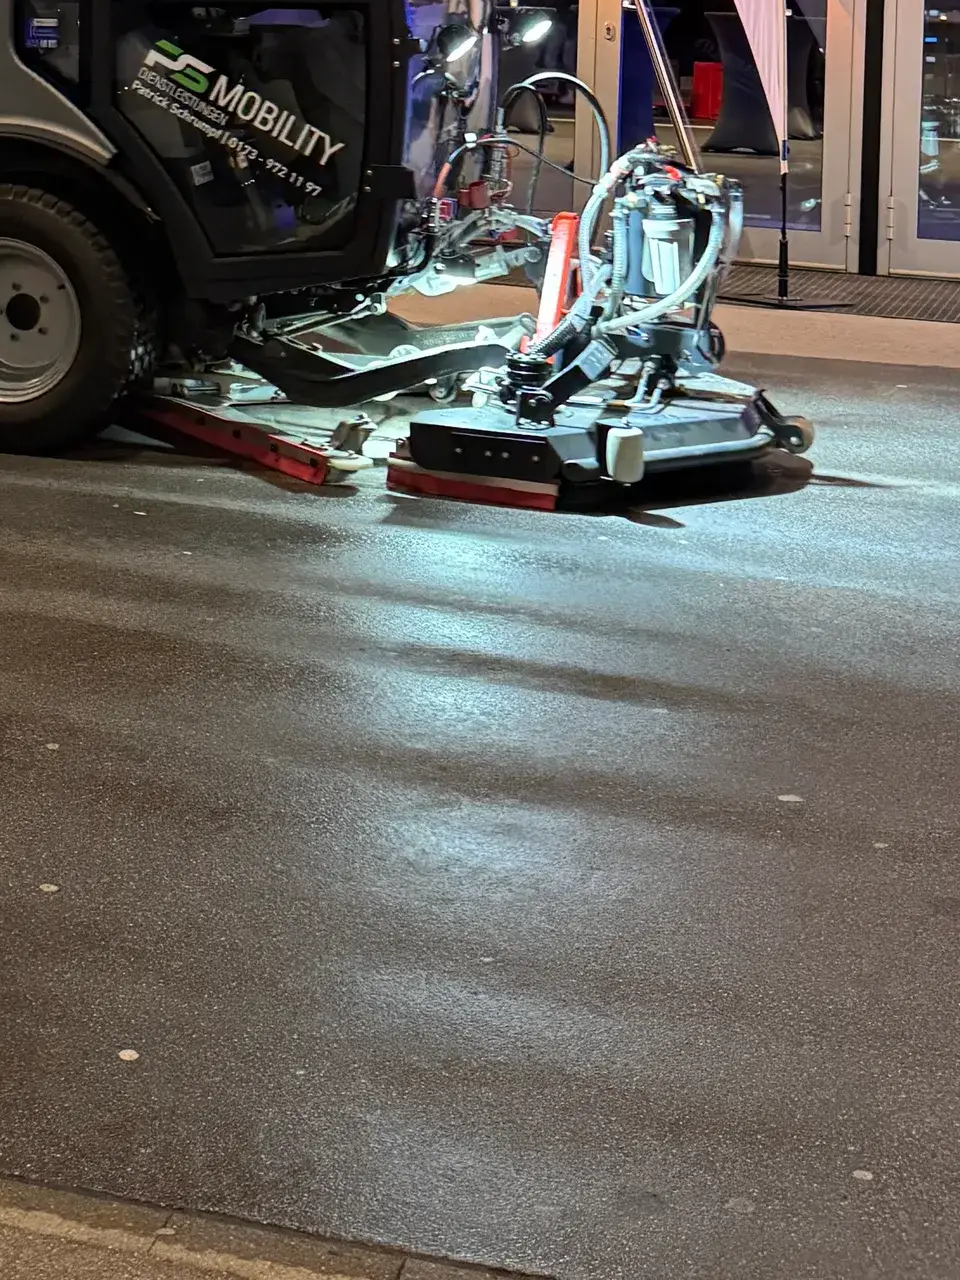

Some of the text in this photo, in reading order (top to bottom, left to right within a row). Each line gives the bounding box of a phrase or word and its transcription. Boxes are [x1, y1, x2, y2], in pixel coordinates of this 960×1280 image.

[131, 80, 170, 109] Patrick
[169, 103, 222, 139] Schrumpf
[227, 137, 258, 160] 0173
[265, 158, 289, 178] 972
[289, 172, 304, 188] 11
[304, 181, 323, 197] 97
[137, 67, 230, 126] DIENSTLEISTUNGEN
[208, 74, 345, 167] MOBILITY
